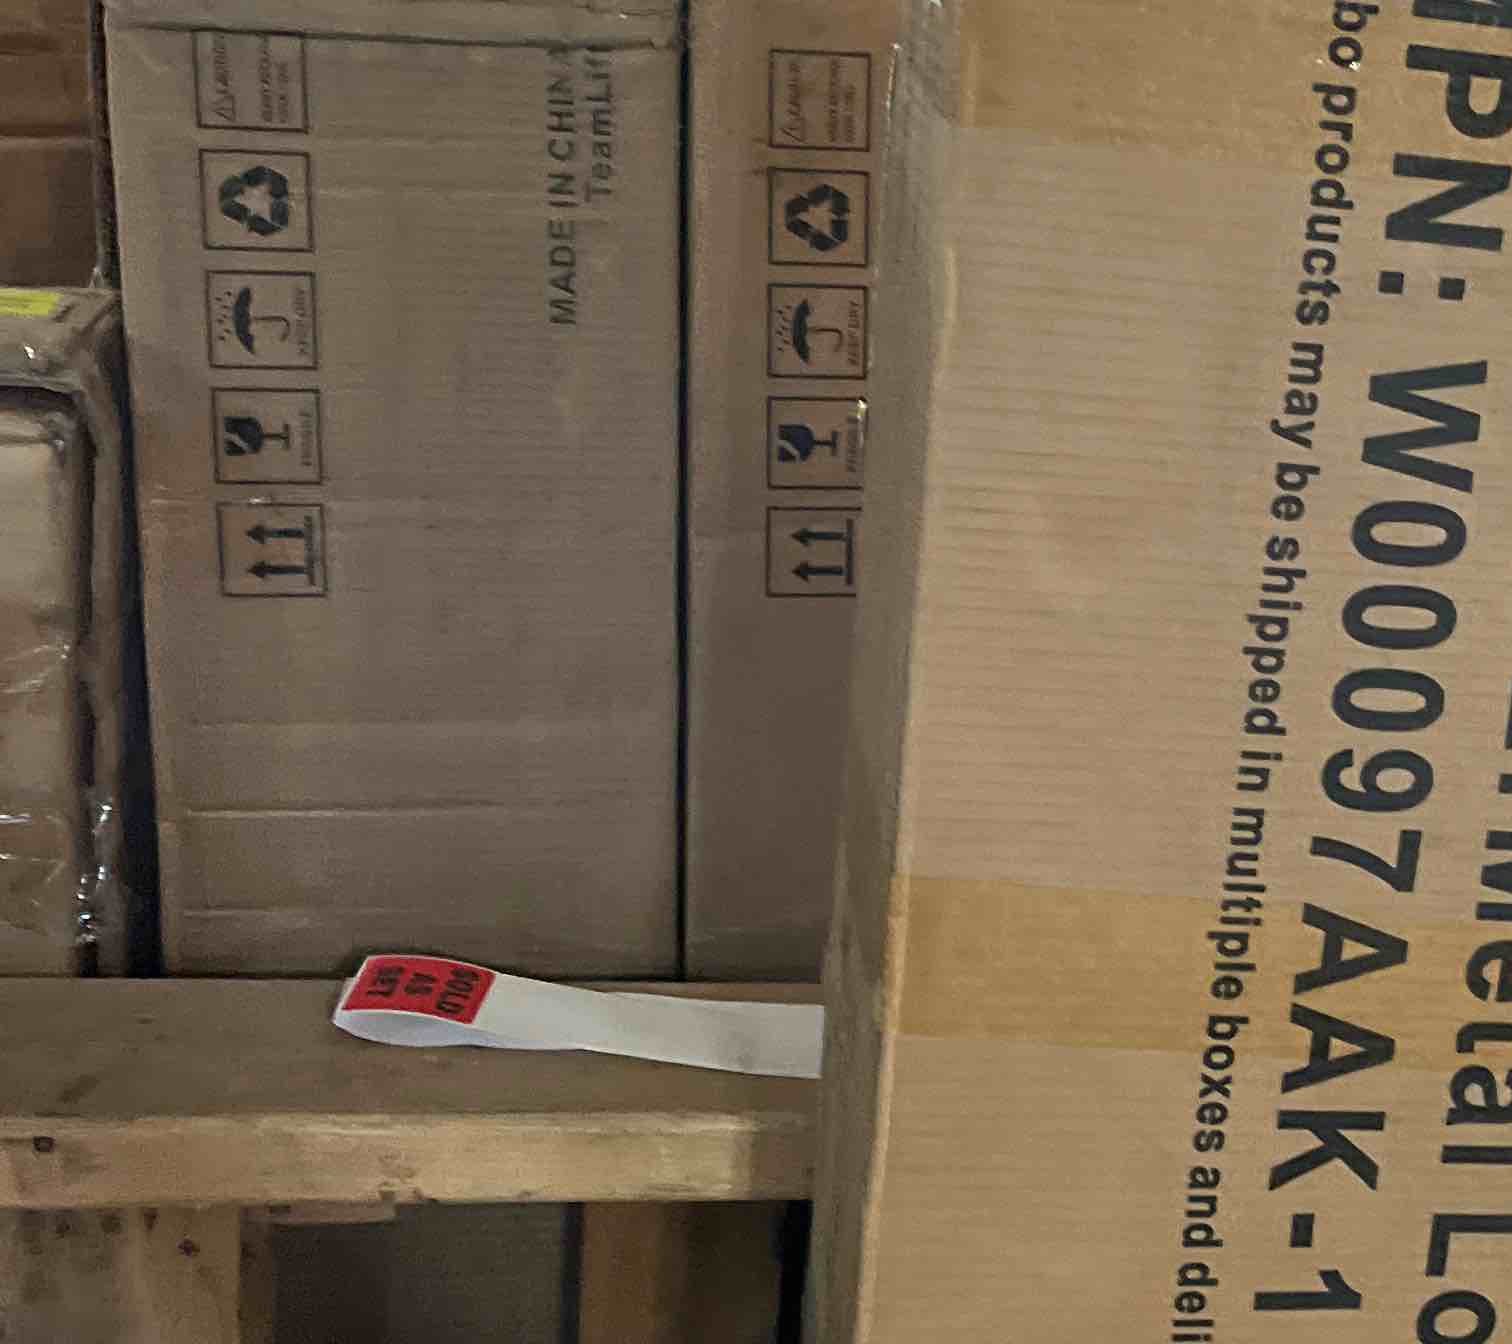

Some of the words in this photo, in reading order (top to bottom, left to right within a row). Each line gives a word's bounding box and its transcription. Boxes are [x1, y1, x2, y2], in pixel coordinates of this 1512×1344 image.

[547, 173, 579, 207] IN
[1294, 83, 1357, 327] products
[548, 218, 577, 325] MADE
[1266, 342, 1323, 448] may
[1268, 462, 1318, 521] be
[1240, 537, 1306, 735] shipped
[1236, 751, 1285, 792] in
[1252, 360, 1489, 1314] W00097AAK-1
[1204, 808, 1271, 999] multiple
[404, 972, 437, 996] AS
[437, 969, 479, 1014] SOLD
[1189, 1014, 1250, 1152] boxes
[1177, 1166, 1223, 1248] and
